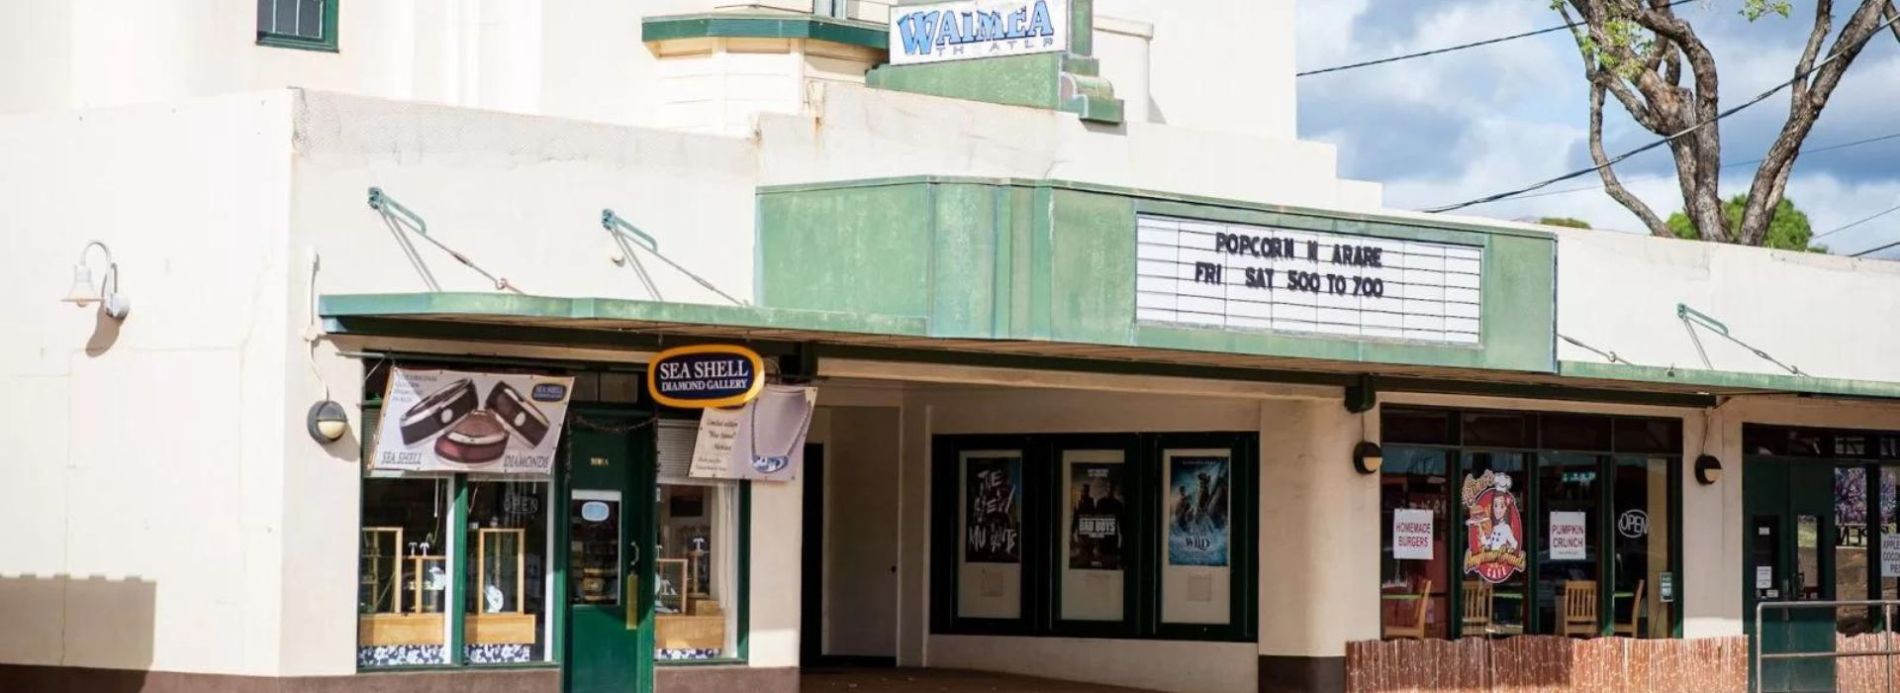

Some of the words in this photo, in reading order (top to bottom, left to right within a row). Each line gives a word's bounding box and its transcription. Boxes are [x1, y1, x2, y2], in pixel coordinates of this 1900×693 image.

[897, 0, 1054, 55] WAIMEA
[1215, 232, 1294, 260] POPCORN
[1307, 240, 1318, 263] N
[1332, 244, 1382, 268] ARARE
[1195, 262, 1221, 285] FRI
[1245, 266, 1274, 290] SAT
[1326, 273, 1347, 296] TO
[1352, 276, 1383, 298] 700
[660, 362, 691, 379] SEA
[694, 360, 749, 378] SHELL
[662, 380, 705, 391] DIAMOND
[706, 379, 748, 389] GALLERY
[503, 454, 550, 469] DIAMONDS
[1396, 522, 1431, 534] HOMEMADE
[1552, 524, 1584, 535] PUMPKIN
[1620, 512, 1648, 534] OPEN
[1398, 536, 1428, 548] BURGERS
[1553, 537, 1583, 549] CRUNCH
